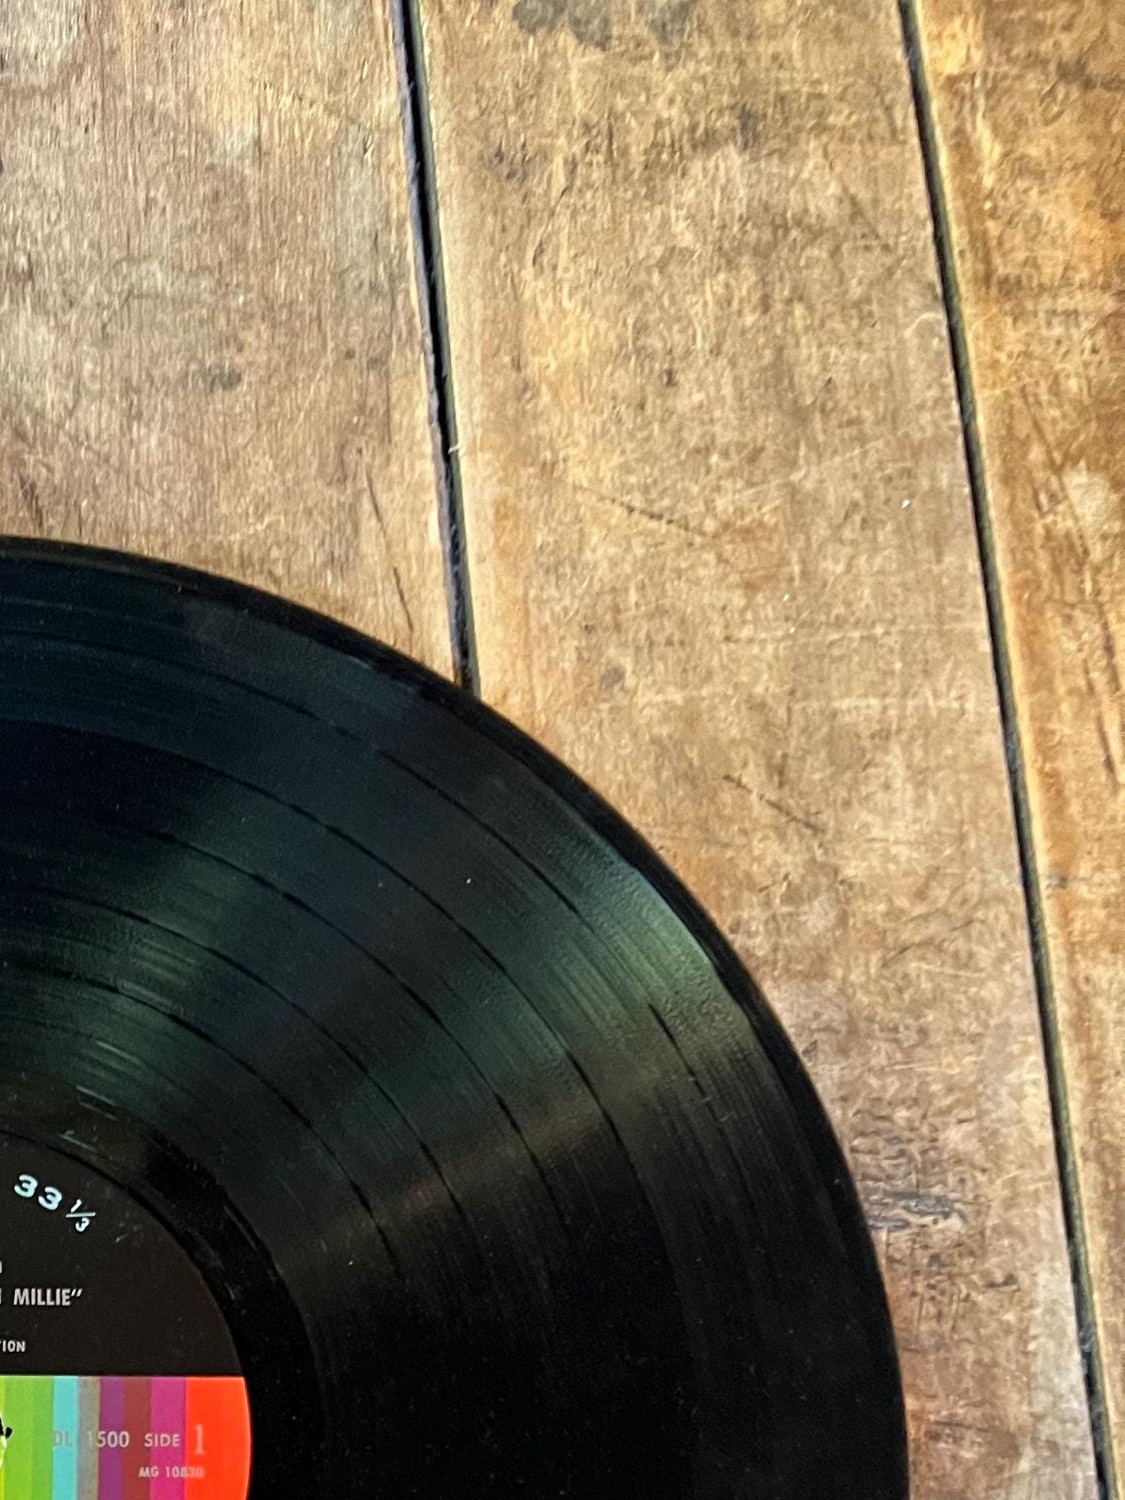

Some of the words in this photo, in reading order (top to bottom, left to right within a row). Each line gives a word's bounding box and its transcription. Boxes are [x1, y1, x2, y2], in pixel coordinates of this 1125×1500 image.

[86, 1430, 130, 1448] 1500
[144, 1433, 180, 1448] SIDE
[194, 1423, 205, 1455] 1
[138, 1466, 159, 1478] MG
